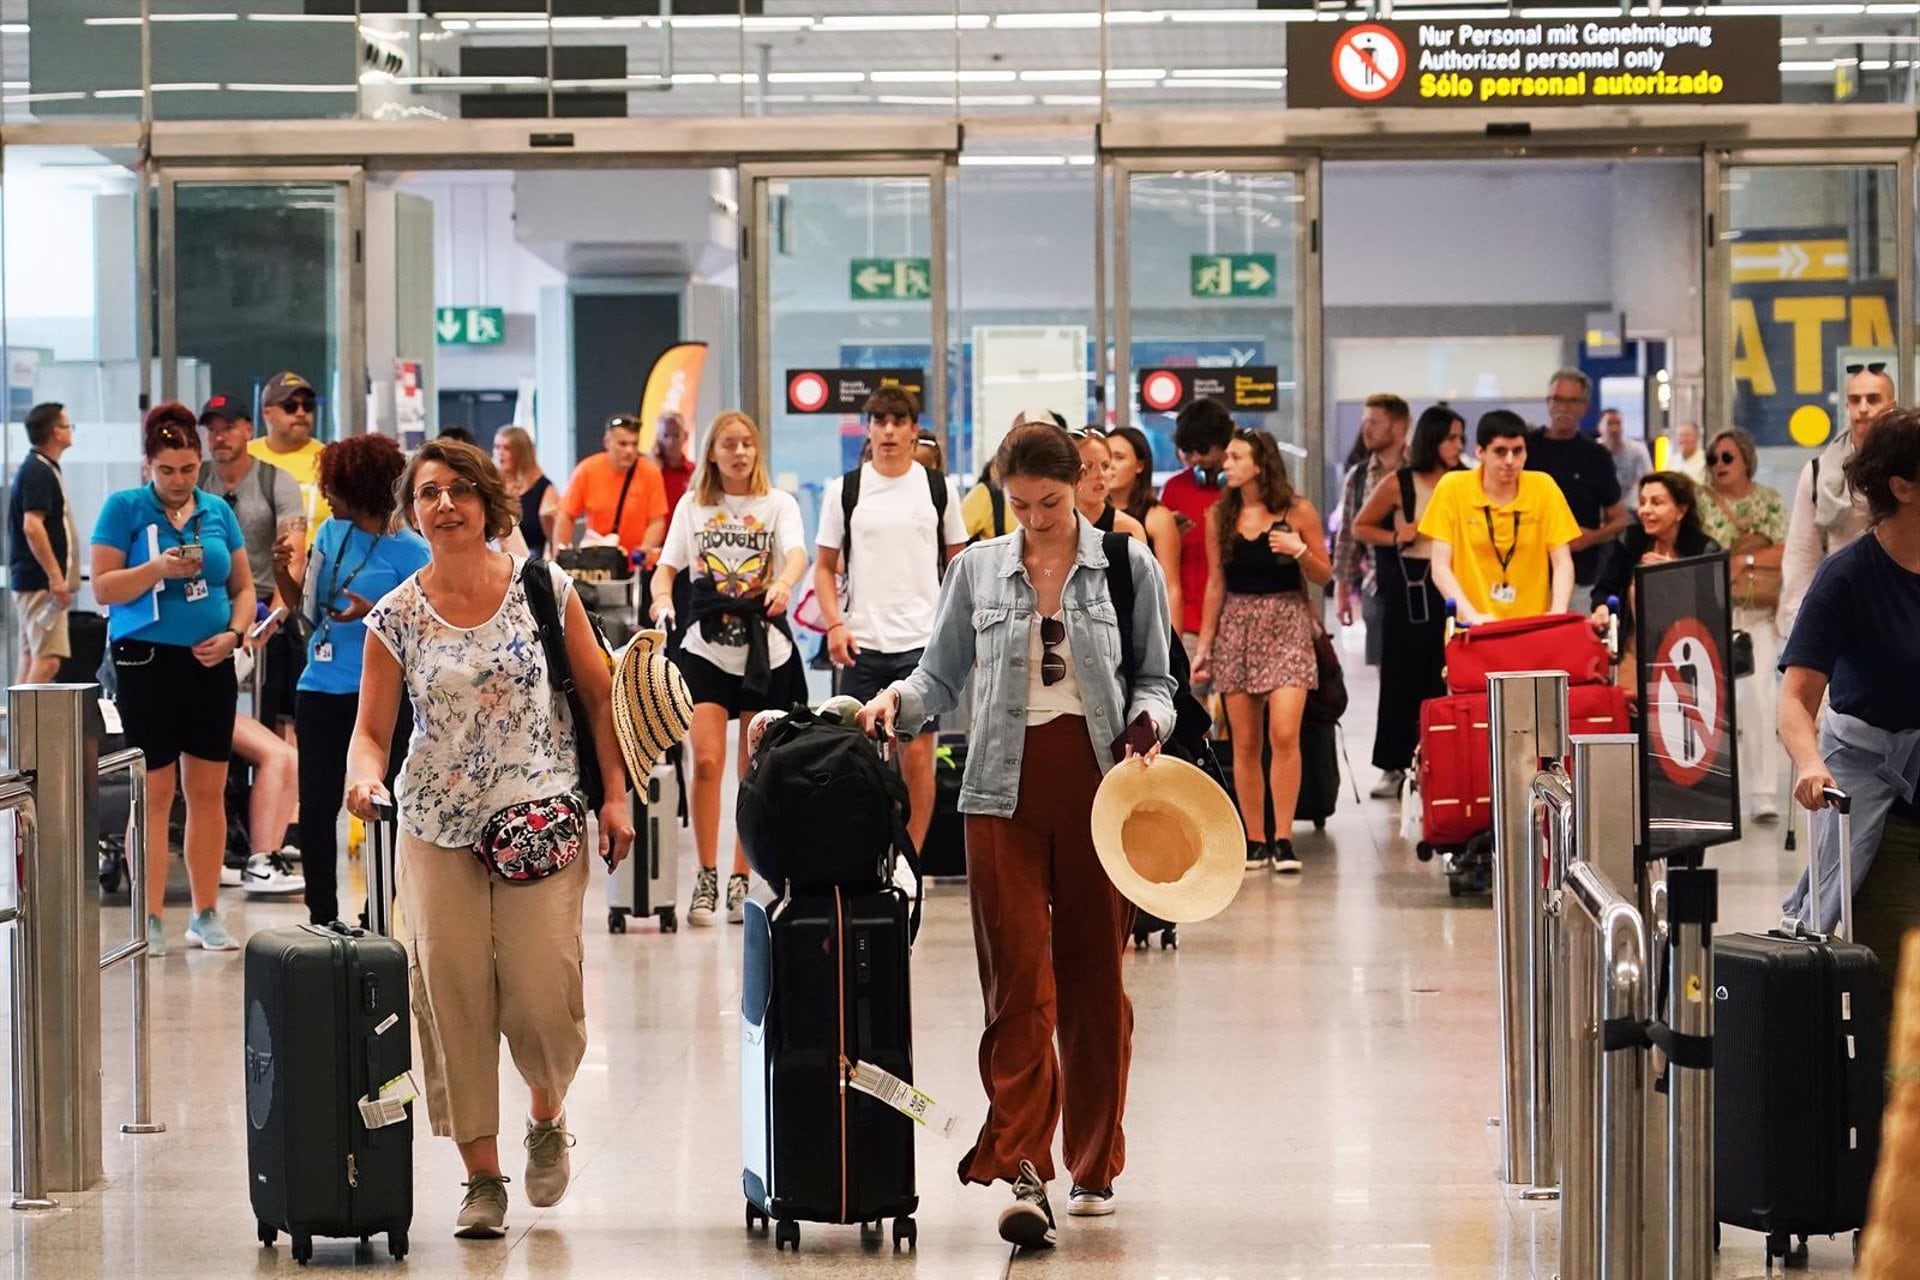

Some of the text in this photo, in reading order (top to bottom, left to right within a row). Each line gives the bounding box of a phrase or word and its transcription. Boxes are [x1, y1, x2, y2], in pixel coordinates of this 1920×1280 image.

[1419, 22, 1712, 47] Nur Personal mit Genehmigung
[1419, 46, 1664, 73] Authorized personnel only
[1420, 70, 1723, 101] Sólo personal autorizado
